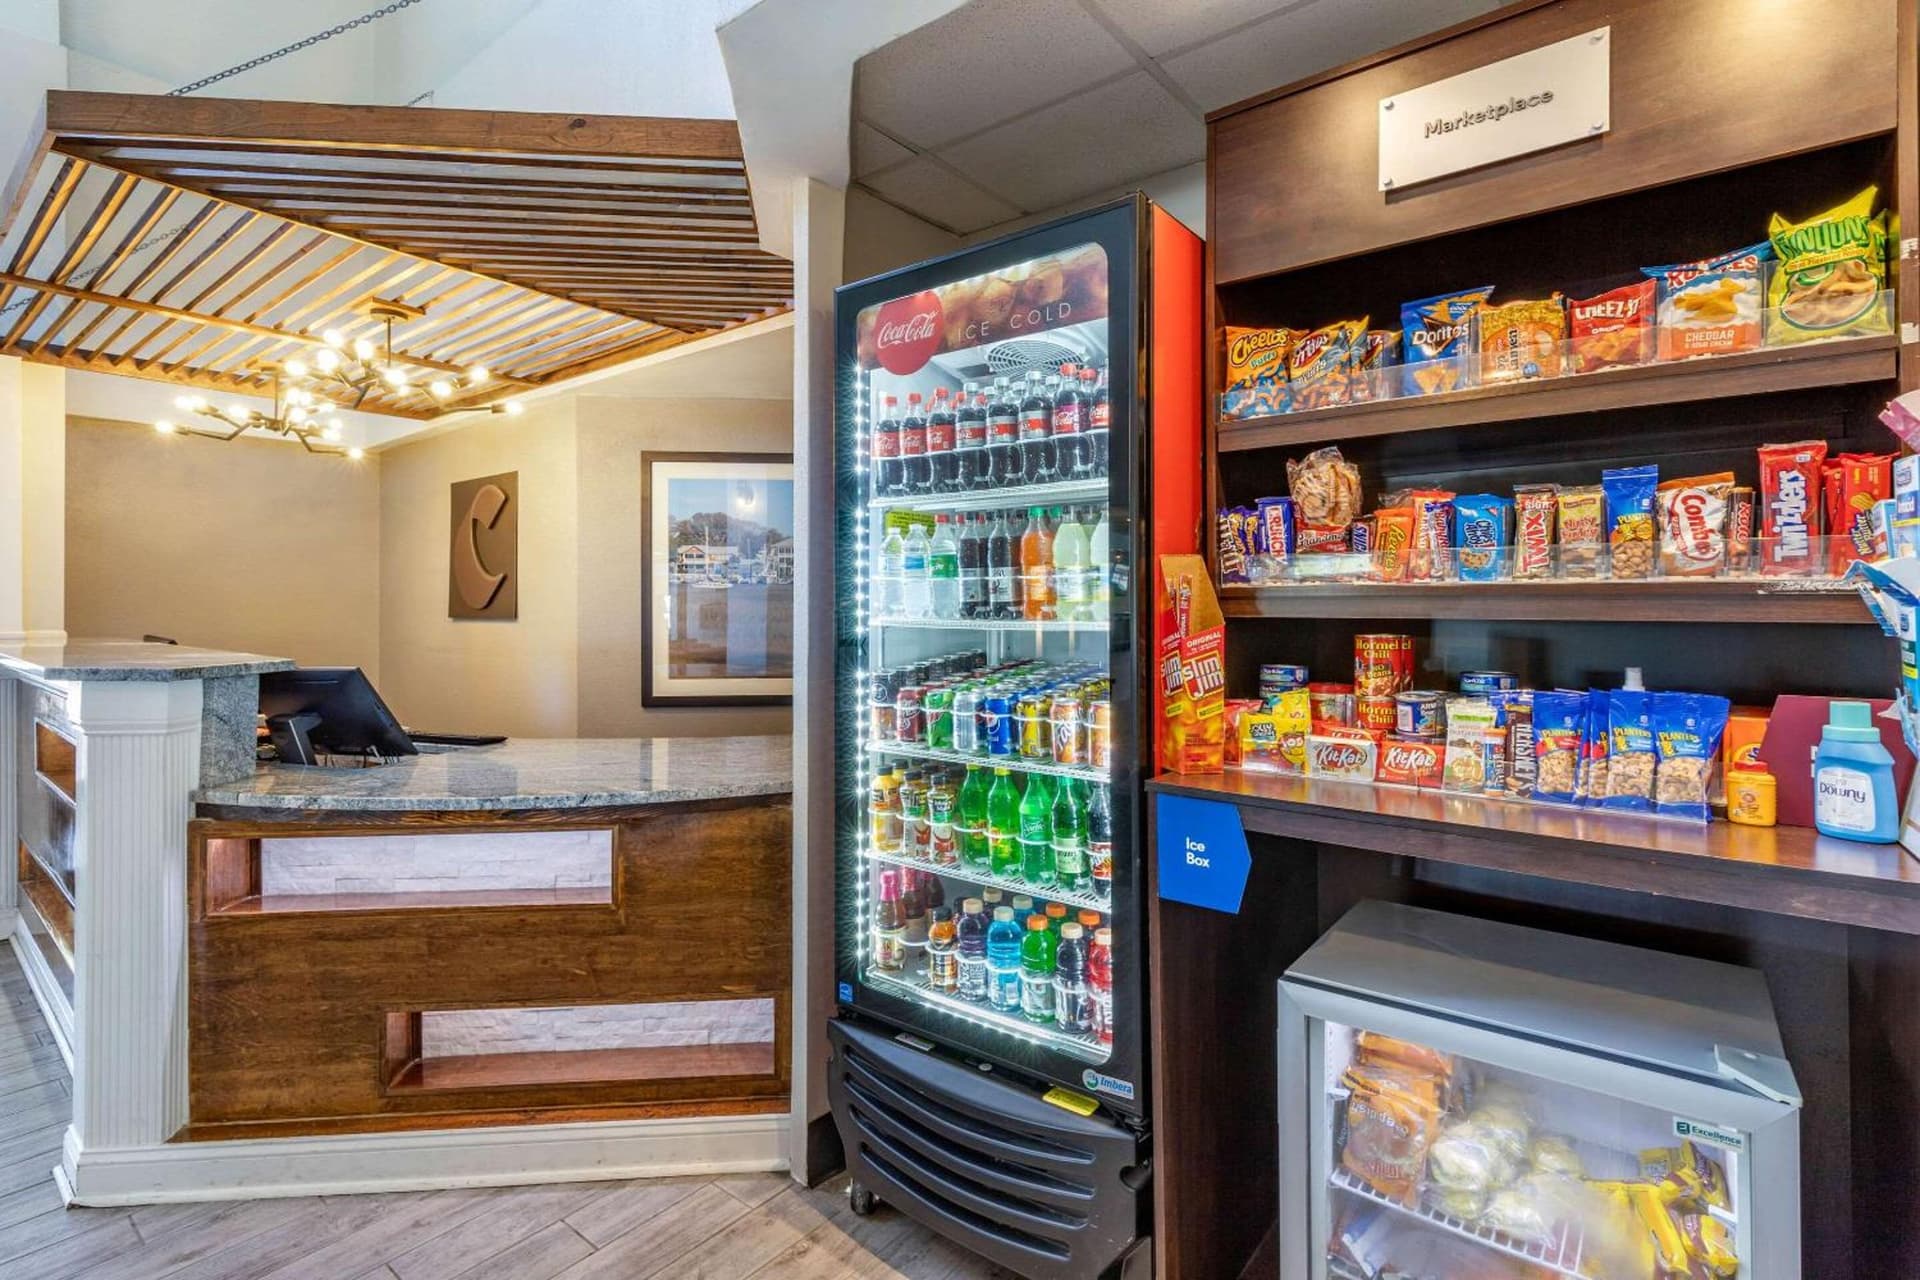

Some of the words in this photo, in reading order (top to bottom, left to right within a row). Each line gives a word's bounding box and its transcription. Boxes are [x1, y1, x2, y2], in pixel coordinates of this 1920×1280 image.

[1424, 90, 1554, 138] Marketplace
[957, 321, 990, 341] ICE
[1010, 302, 1072, 330] COLD
[1412, 323, 1469, 345] Doritos
[1685, 329, 1735, 343] CHEDDAR
[1231, 328, 1289, 367] Cheetos
[1292, 332, 1329, 367] Fritos
[1356, 639, 1399, 650] Hormel
[1364, 650, 1390, 659] Chili
[1359, 703, 1397, 715] Horm
[1367, 714, 1394, 724] Chili
[1819, 781, 1867, 804] Downy
[1185, 837, 1205, 852] Ice
[1186, 852, 1210, 868] Box
[1100, 1076, 1132, 1094] Imbera
[1692, 1125, 1742, 1146] Excellence
